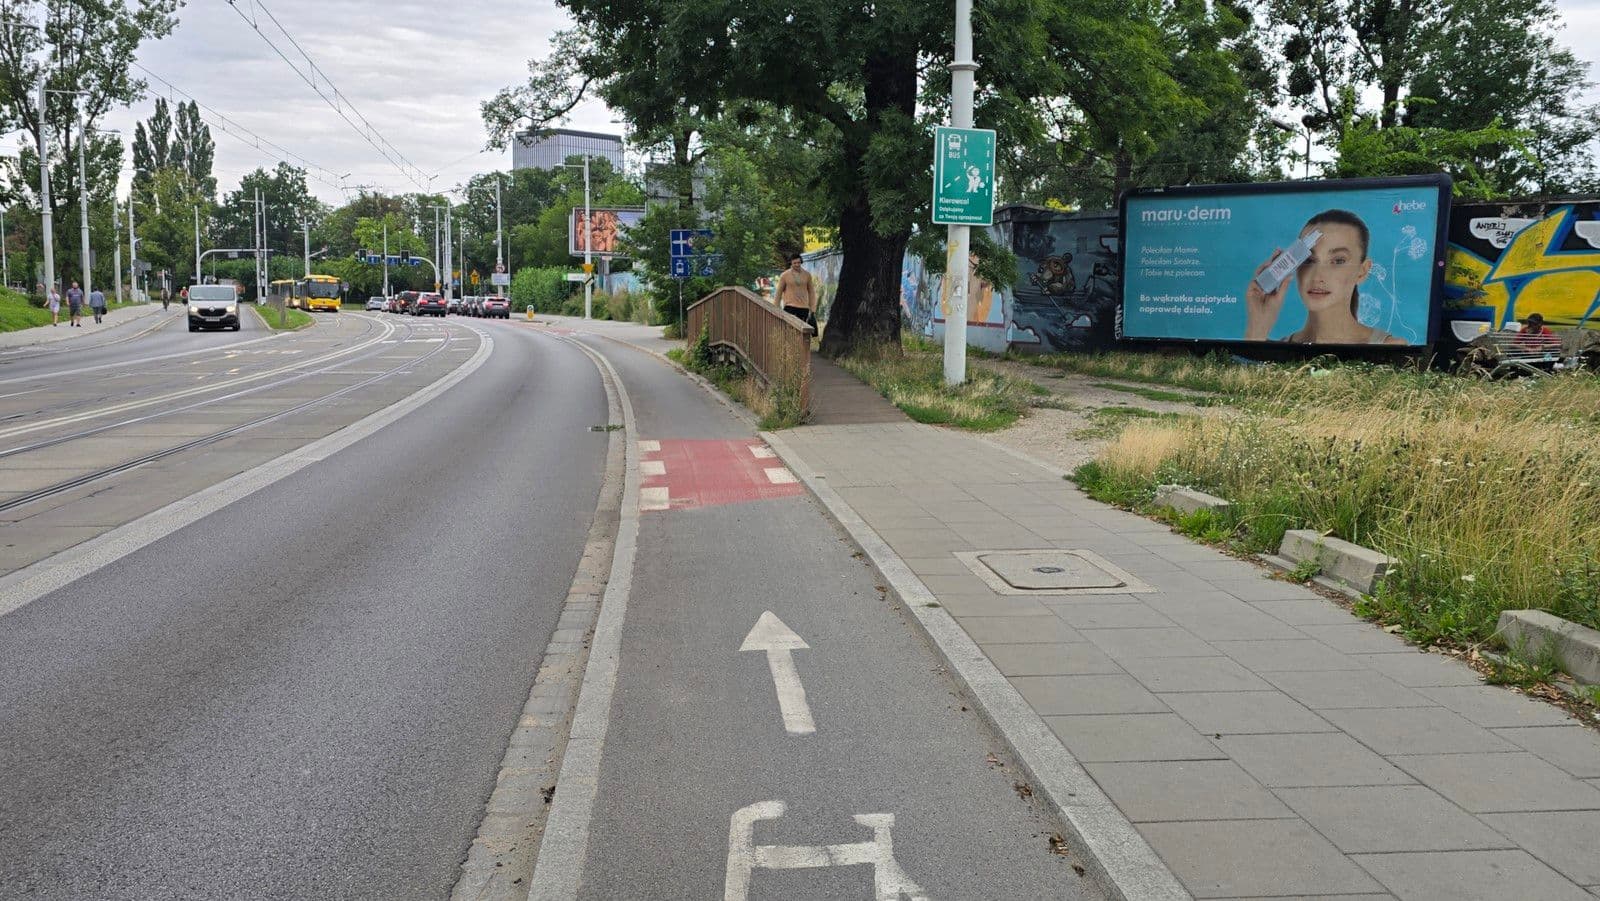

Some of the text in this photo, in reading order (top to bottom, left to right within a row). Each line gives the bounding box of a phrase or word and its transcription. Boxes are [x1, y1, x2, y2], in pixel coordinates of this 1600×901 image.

[1398, 200, 1426, 210] hebe
[1153, 294, 1193, 304] wąkrotka
[1195, 295, 1237, 305] azjatycka
[1140, 306, 1182, 315] naprawdę
